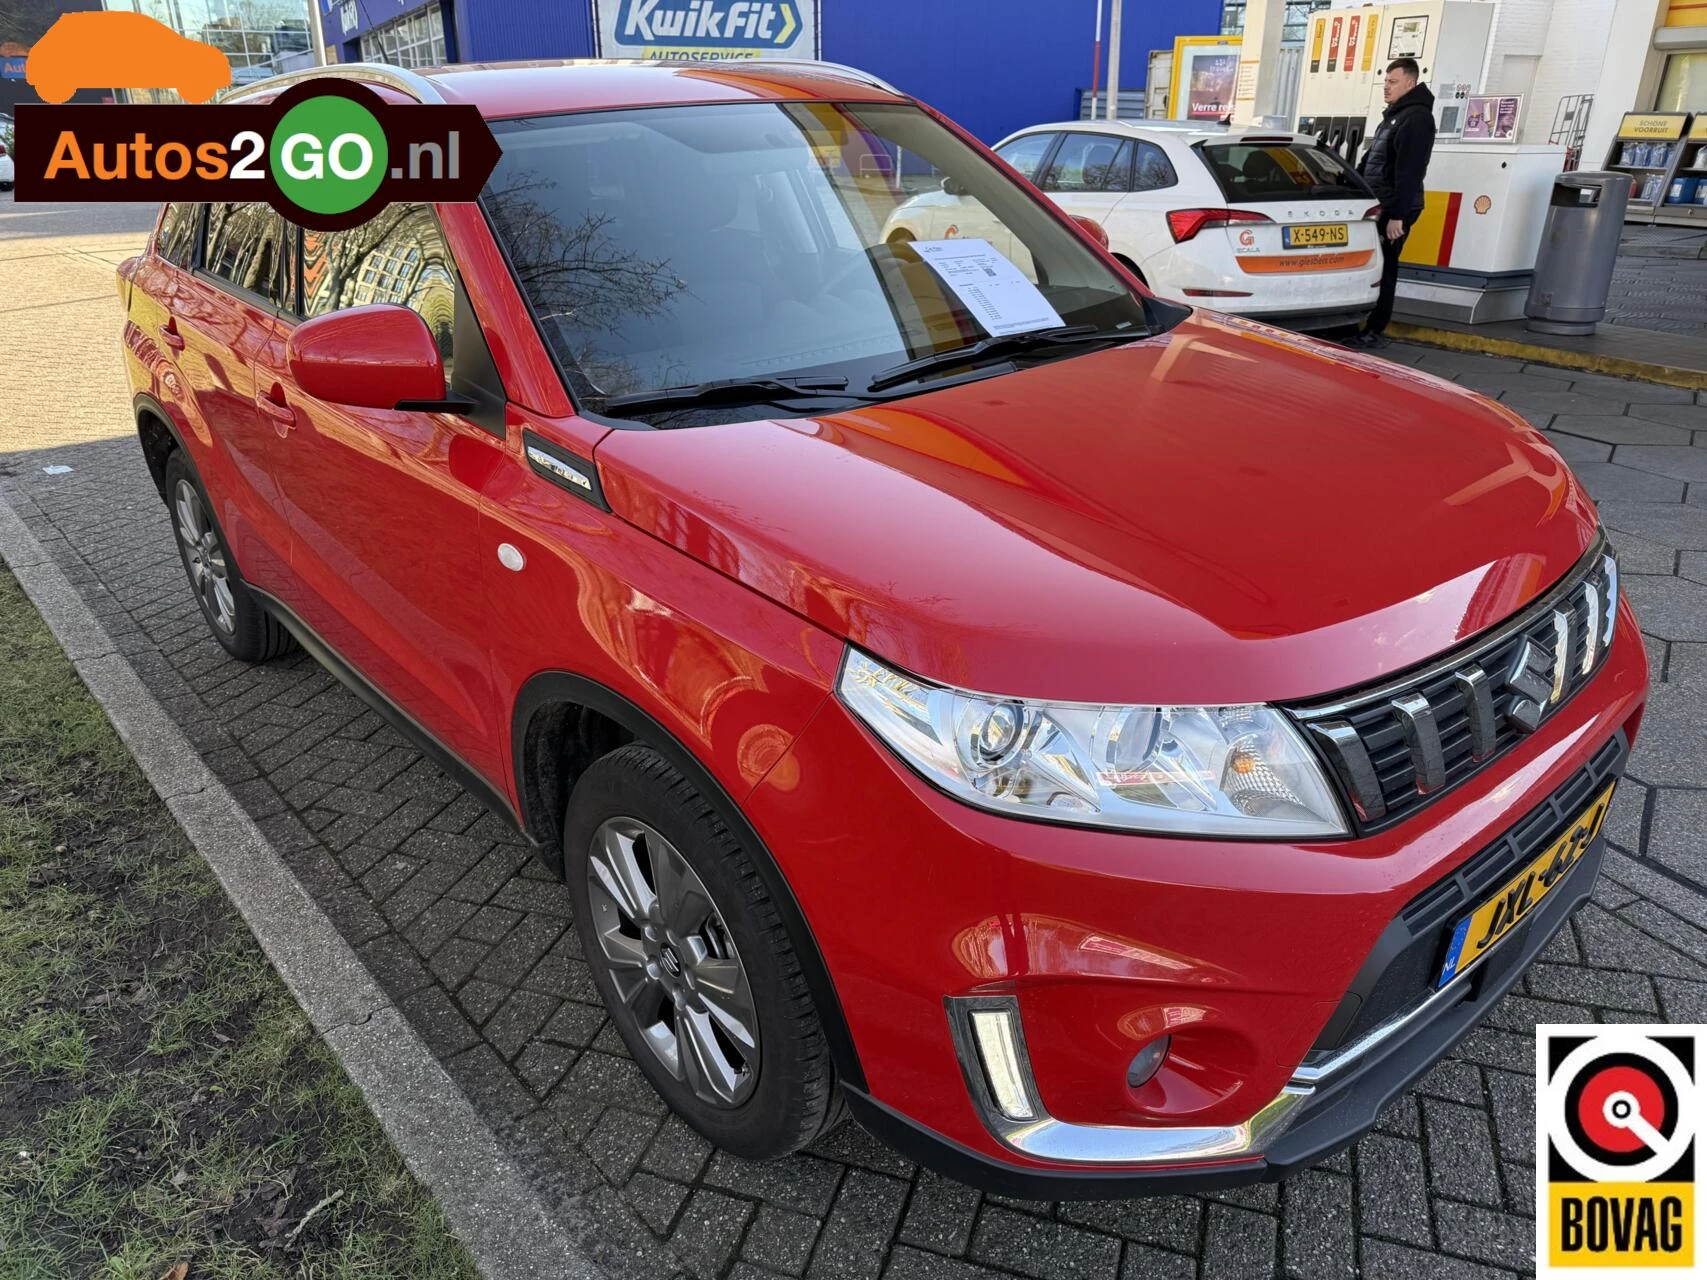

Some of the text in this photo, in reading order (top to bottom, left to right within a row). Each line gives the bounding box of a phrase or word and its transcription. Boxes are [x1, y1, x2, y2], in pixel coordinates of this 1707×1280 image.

[1191, 102, 1217, 112] Verre
[1634, 126, 1669, 134] VOORRUIT
[1293, 226, 1345, 243] X-549-NS
